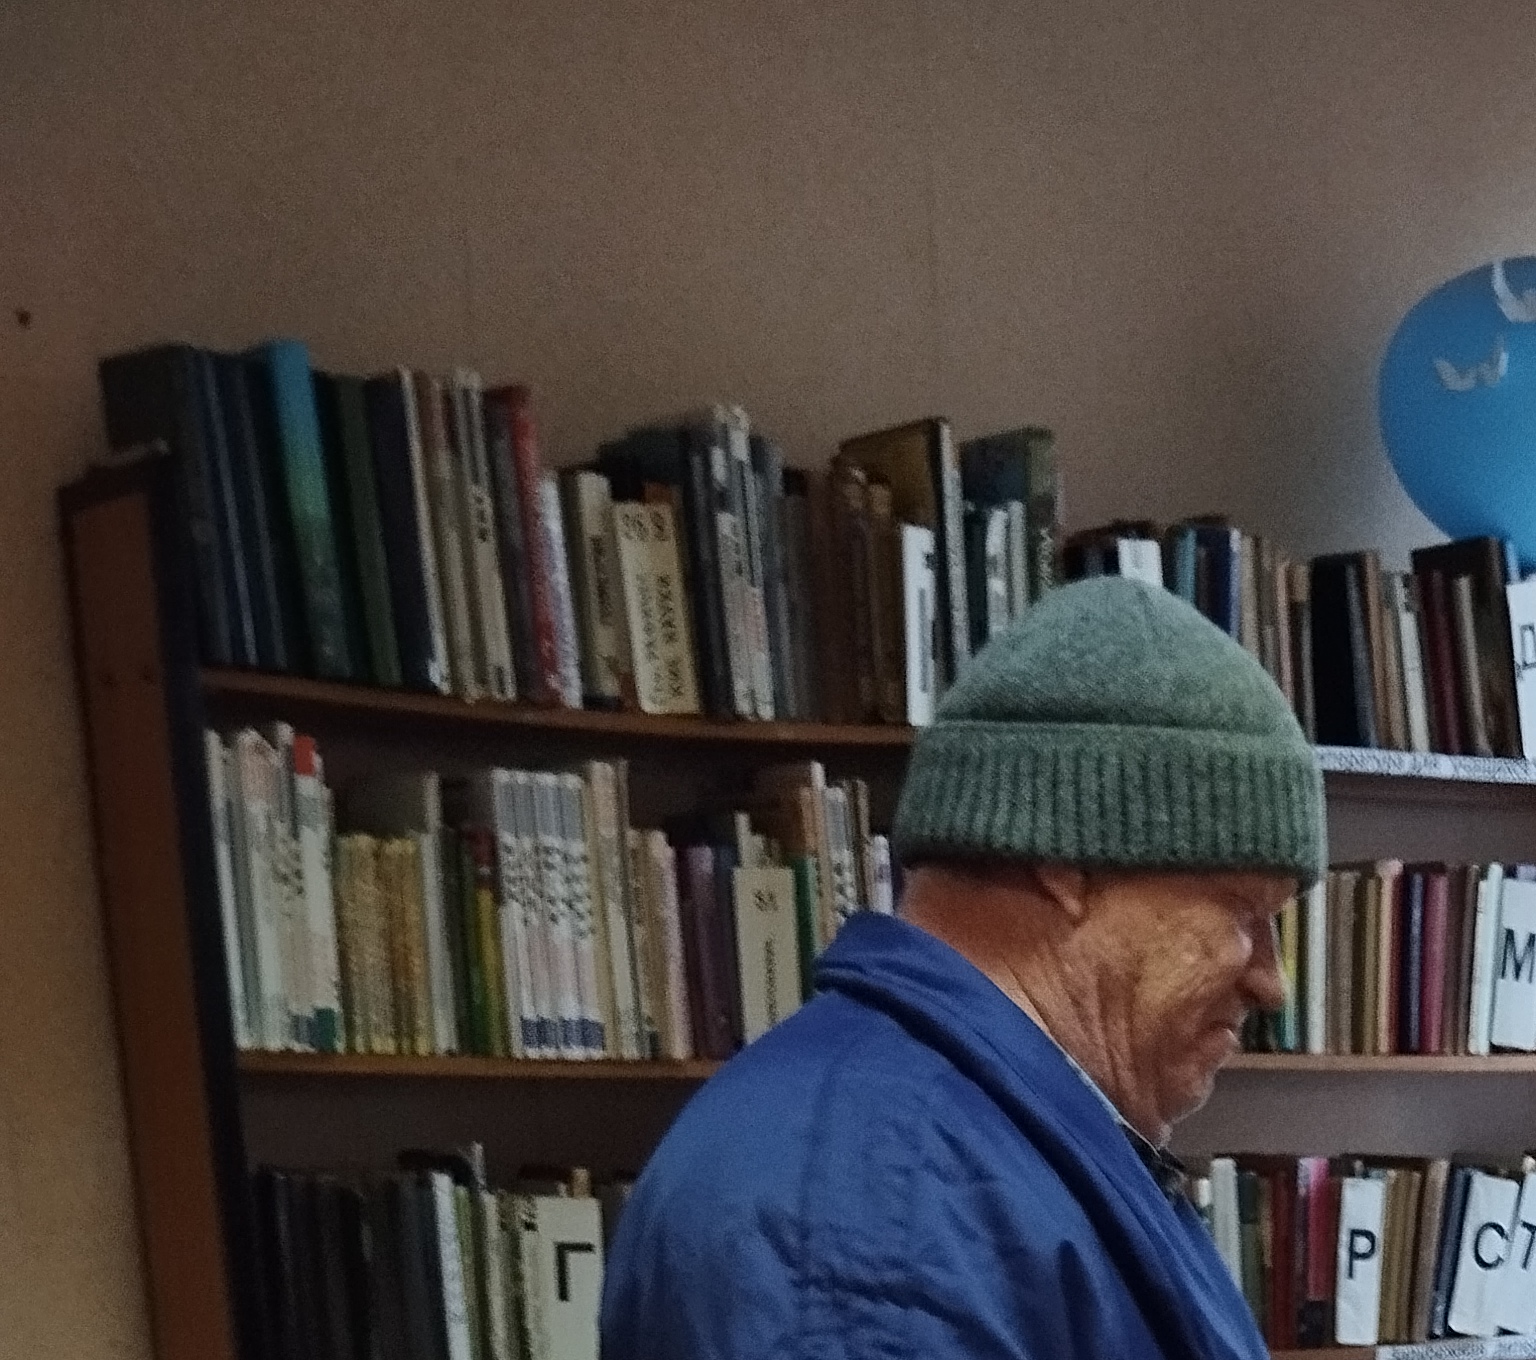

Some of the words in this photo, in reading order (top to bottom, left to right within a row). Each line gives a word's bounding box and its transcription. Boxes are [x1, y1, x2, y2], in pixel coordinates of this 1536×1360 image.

[1501, 927, 1536, 985] М
[553, 1241, 596, 1302] Г
[1347, 1228, 1377, 1281] Р
